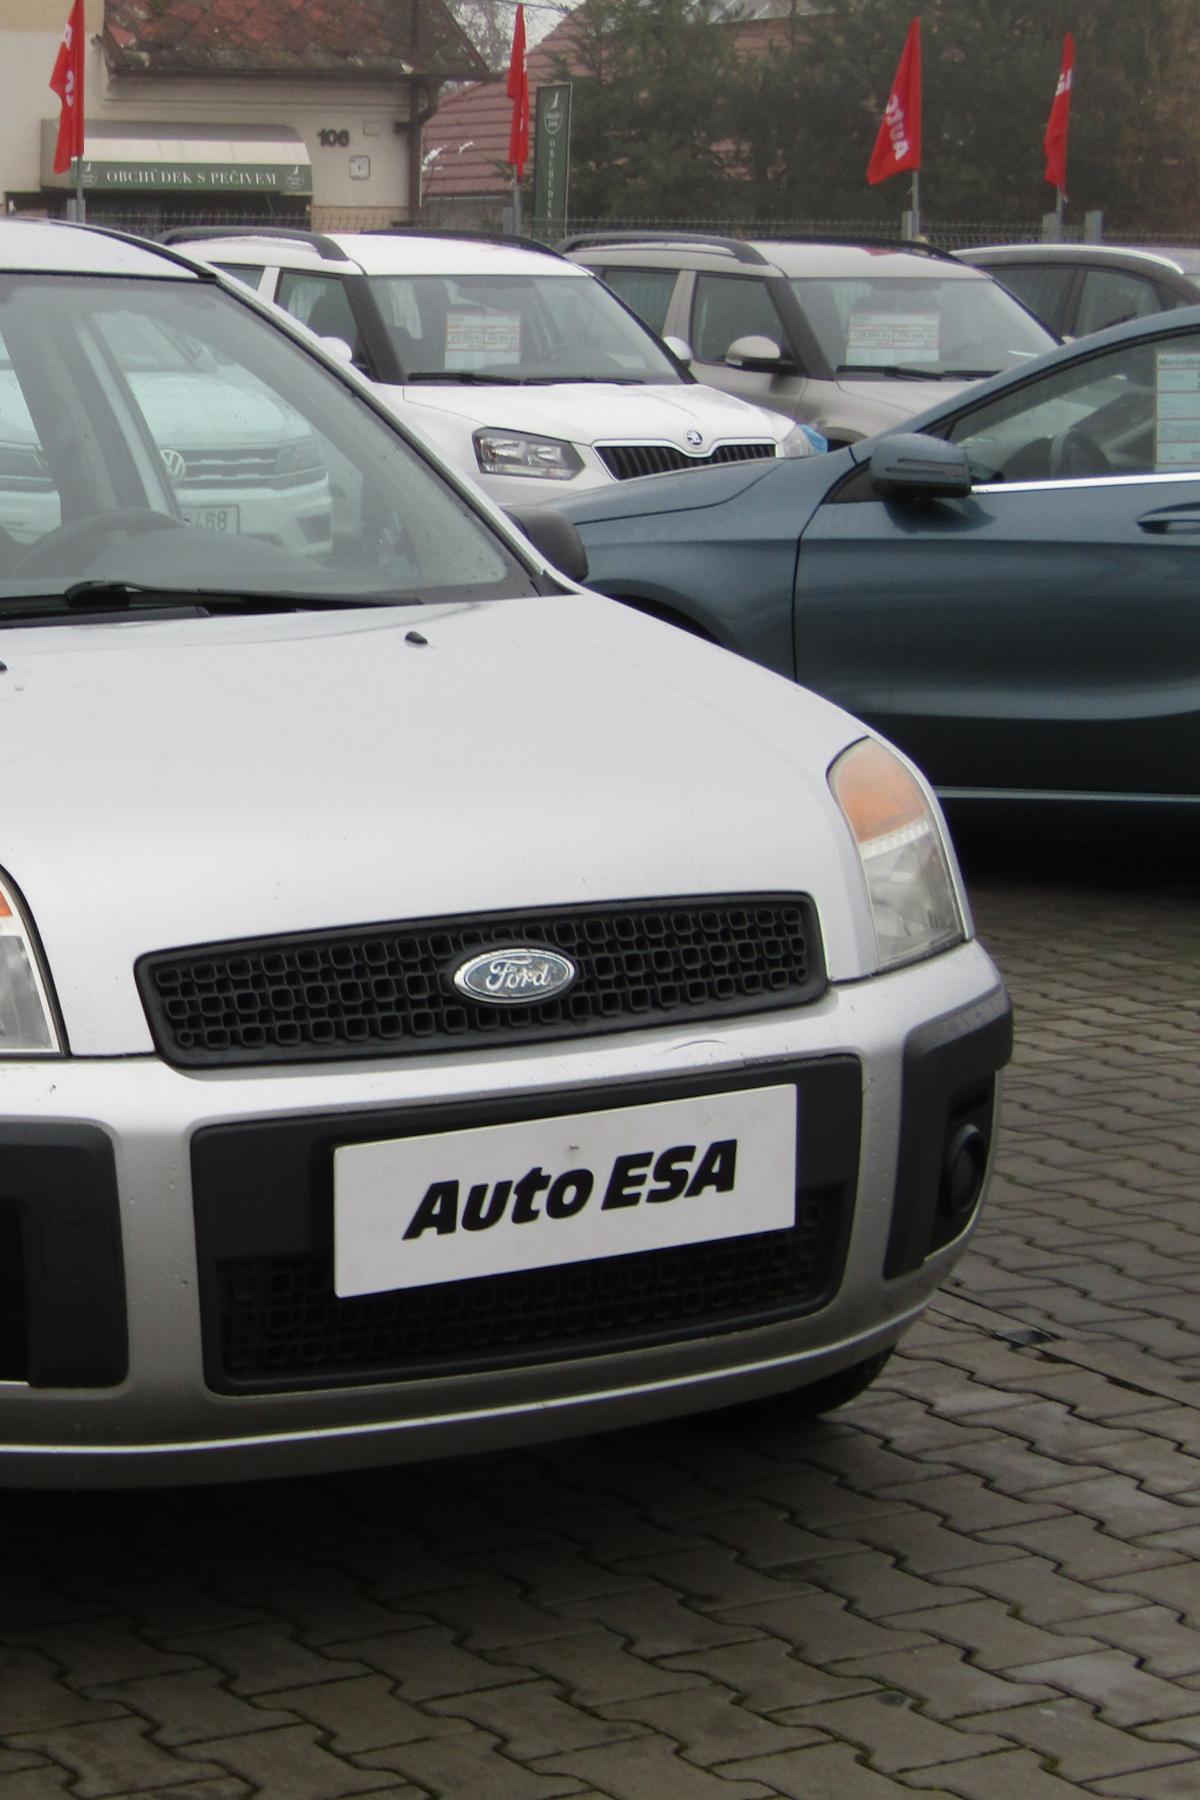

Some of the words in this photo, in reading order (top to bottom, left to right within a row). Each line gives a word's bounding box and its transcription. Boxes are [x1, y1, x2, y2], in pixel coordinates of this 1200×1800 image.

[197, 174, 205, 184] S
[211, 170, 276, 185] PEČIVEM
[486, 958, 550, 991] Ford
[402, 1167, 594, 1240] Auto
[601, 1139, 738, 1211] ESA
